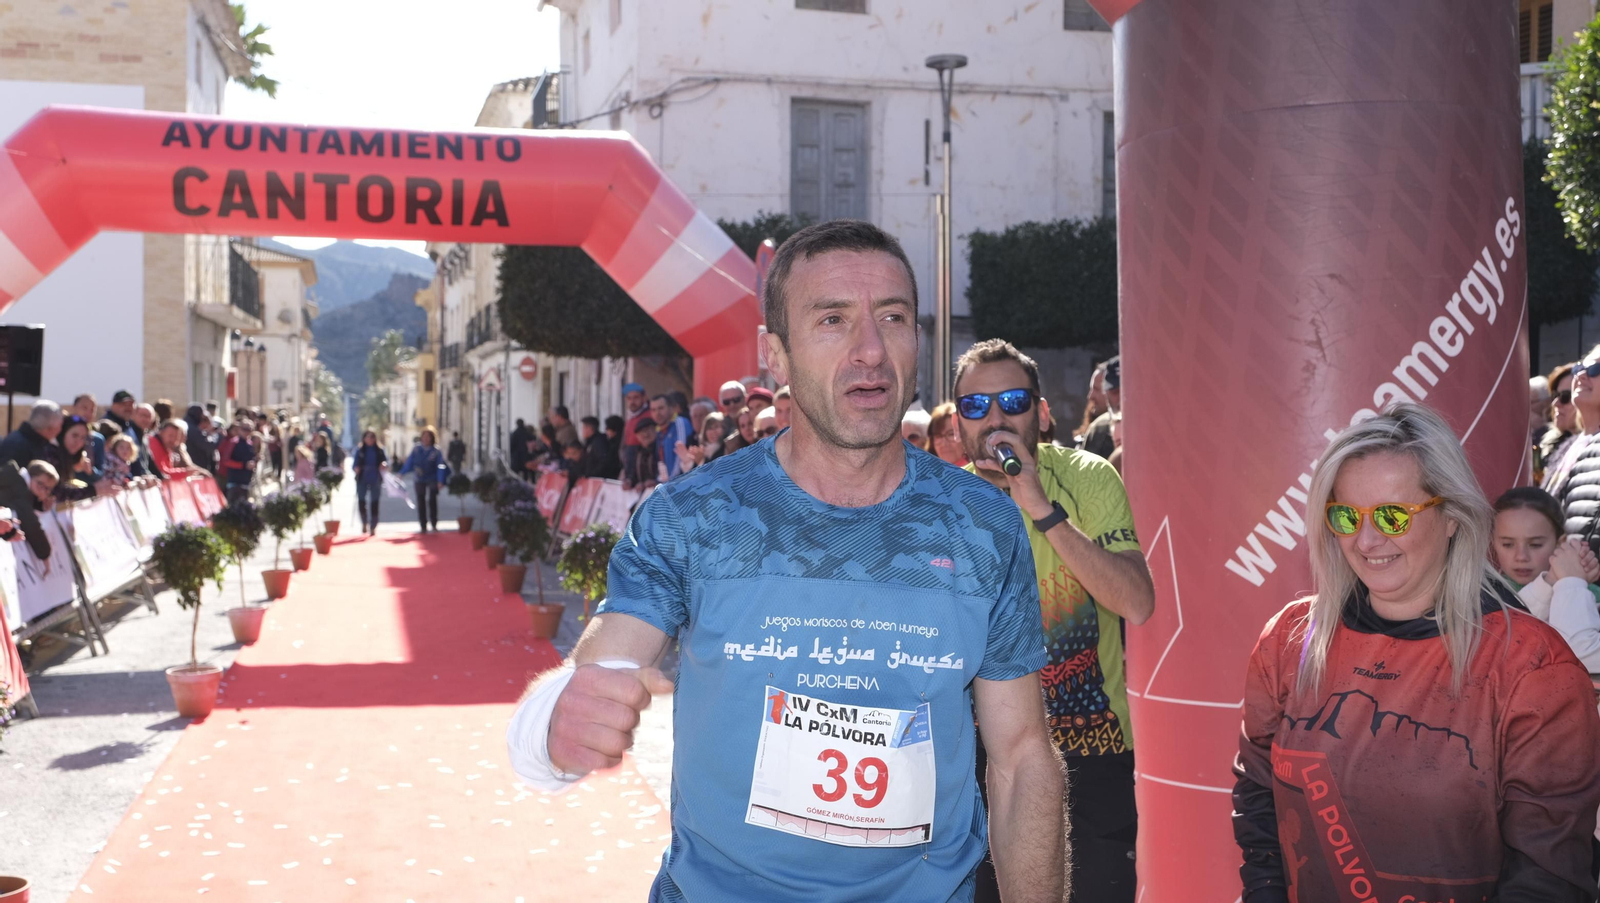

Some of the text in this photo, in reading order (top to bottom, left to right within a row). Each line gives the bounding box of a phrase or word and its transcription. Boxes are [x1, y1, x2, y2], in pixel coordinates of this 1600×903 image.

[162, 121, 522, 162] AYUNTAMIENTO
[172, 166, 510, 228] CANTORIA
[1092, 528, 1139, 549] IKES
[804, 617, 848, 628] Moriscos
[850, 618, 866, 629] de
[868, 620, 897, 631] Aben
[899, 624, 939, 638] Humeya
[723, 635, 964, 673] media legua gruesa
[797, 673, 880, 691] PURCHENA
[1352, 666, 1401, 681] TEAMERGY
[792, 696, 858, 724] IV CxM
[862, 717, 892, 727] Cantoria
[784, 713, 802, 731] LA
[808, 720, 887, 747] PÓLVORA
[812, 748, 889, 809] 39
[1301, 763, 1329, 801] LA
[806, 807, 831, 817] GÓMEZ
